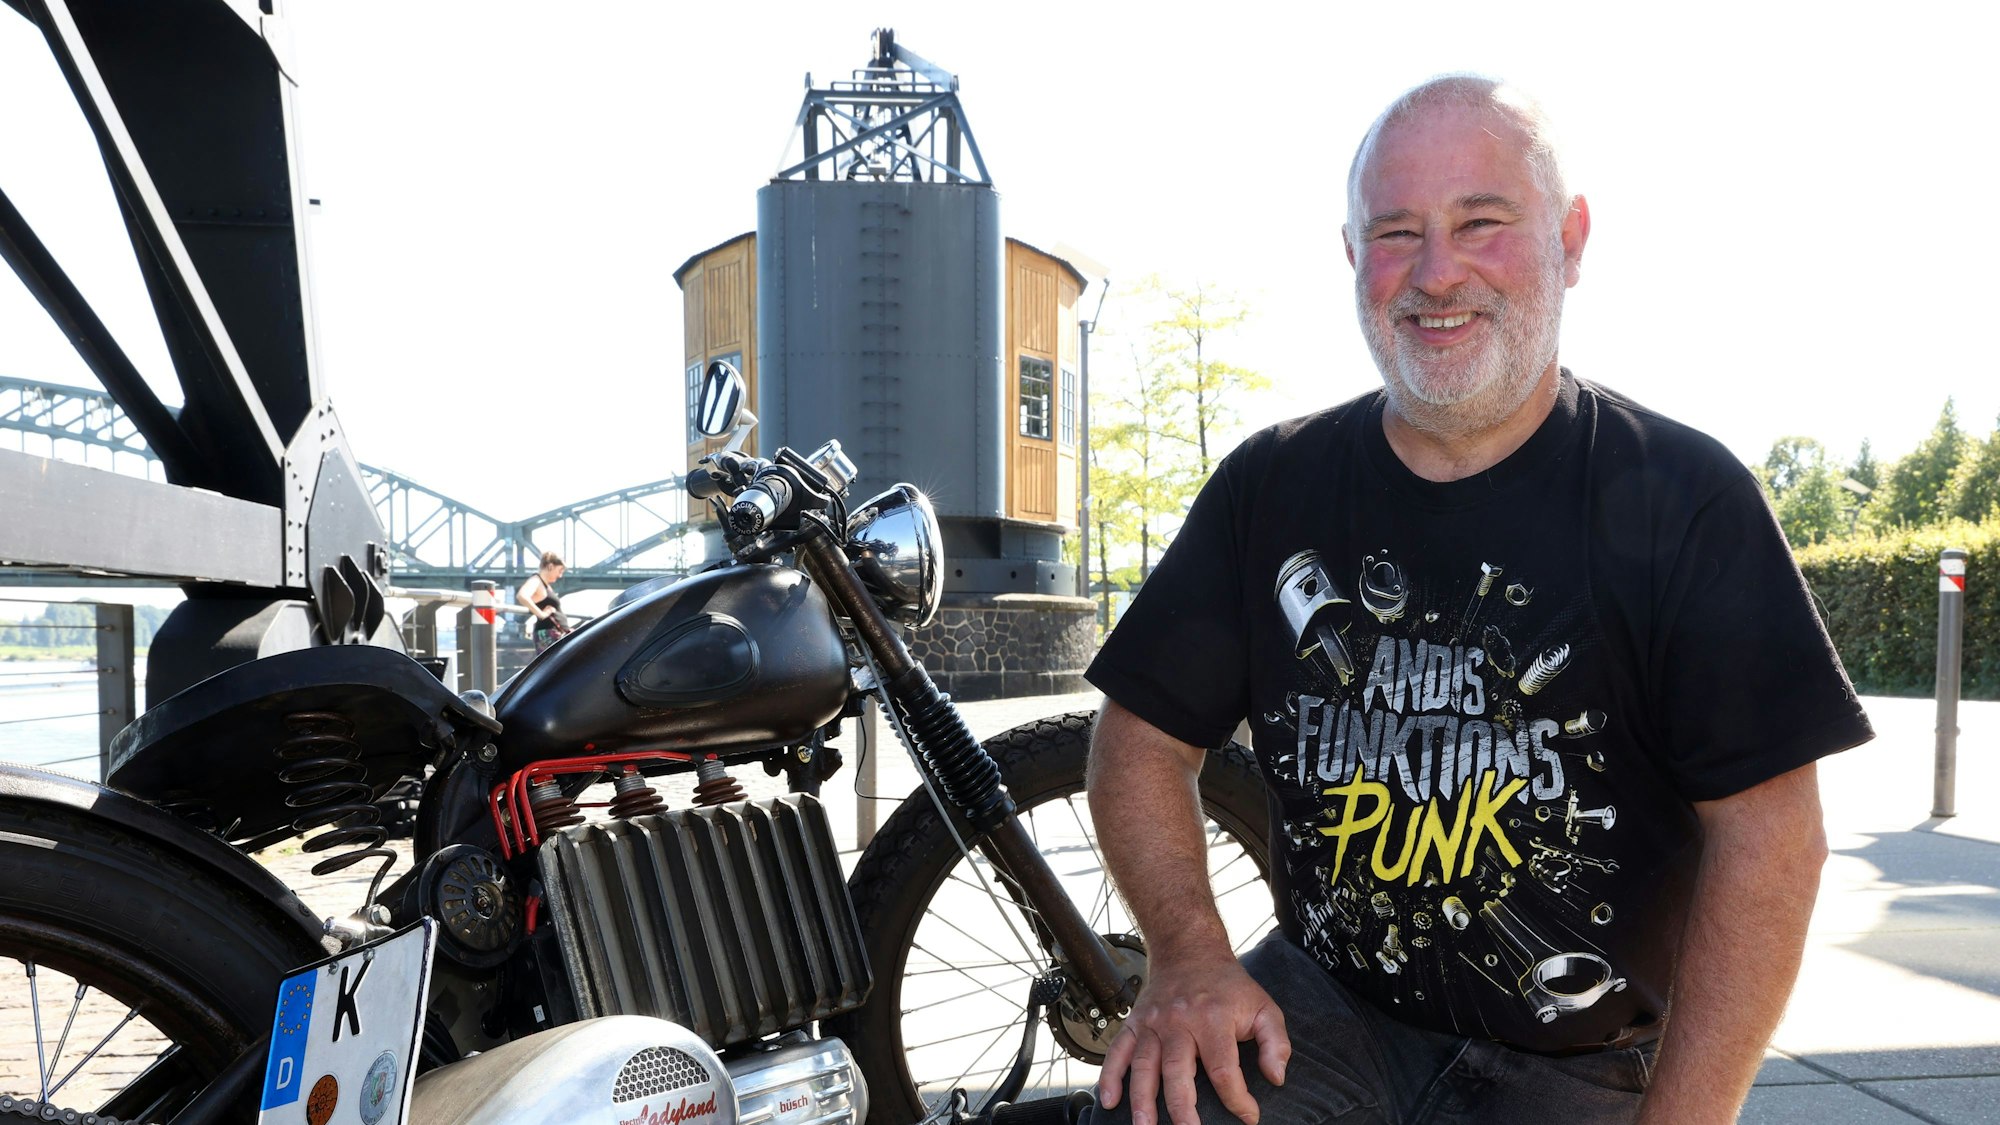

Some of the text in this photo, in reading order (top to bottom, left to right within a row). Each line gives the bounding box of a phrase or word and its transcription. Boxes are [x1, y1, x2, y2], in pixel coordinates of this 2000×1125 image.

[728, 502, 762, 535] RACING COMPONENTS
[1363, 635, 1485, 716] ANDIS
[1297, 695, 1565, 805] FUNKTIONS
[1317, 763, 1528, 888] PUNK
[332, 959, 373, 1042] K
[277, 1057, 293, 1090] D
[780, 1095, 808, 1113] büsch
